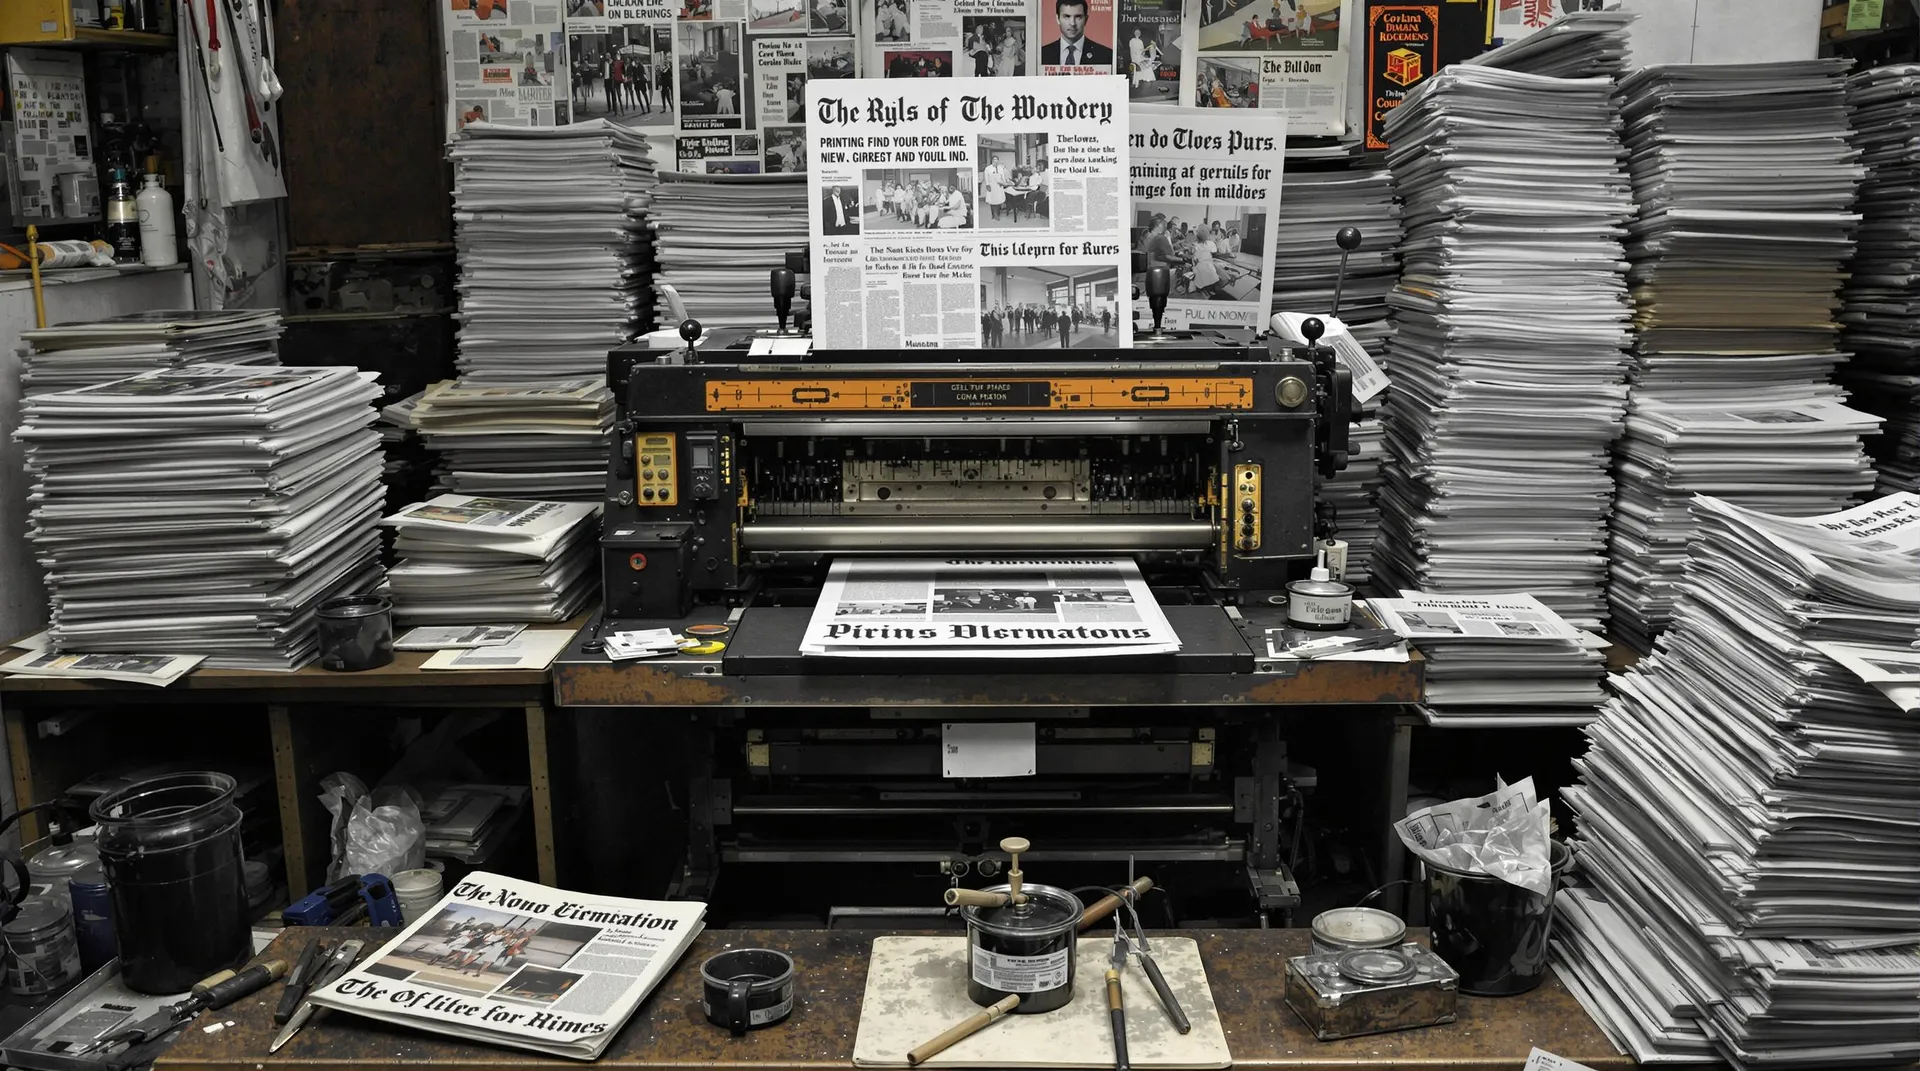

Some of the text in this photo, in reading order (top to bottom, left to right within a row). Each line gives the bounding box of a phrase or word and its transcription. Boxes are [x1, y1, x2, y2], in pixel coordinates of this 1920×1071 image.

[608, 9, 621, 19] ON
[1263, 60, 1282, 74] The
[817, 97, 859, 127] The
[927, 97, 951, 125] of
[960, 95, 1005, 125] The
[1010, 94, 1113, 125] Wondery
[820, 136, 865, 148] PRINTING
[867, 136, 890, 148] FIND
[893, 136, 919, 147] YOUR
[921, 136, 940, 147] FOR
[1150, 129, 1168, 149] do
[1228, 130, 1277, 155] Purs.
[895, 151, 916, 162] AND
[949, 150, 969, 162] IND.
[1181, 164, 1195, 179] at
[1252, 164, 1271, 181] for
[1196, 183, 1210, 198] in
[980, 242, 1009, 257] This
[1060, 242, 1078, 255] for
[823, 622, 938, 642] Pirins
[452, 880, 493, 902] The
[334, 977, 389, 1001] The
[477, 1003, 527, 1029] for
